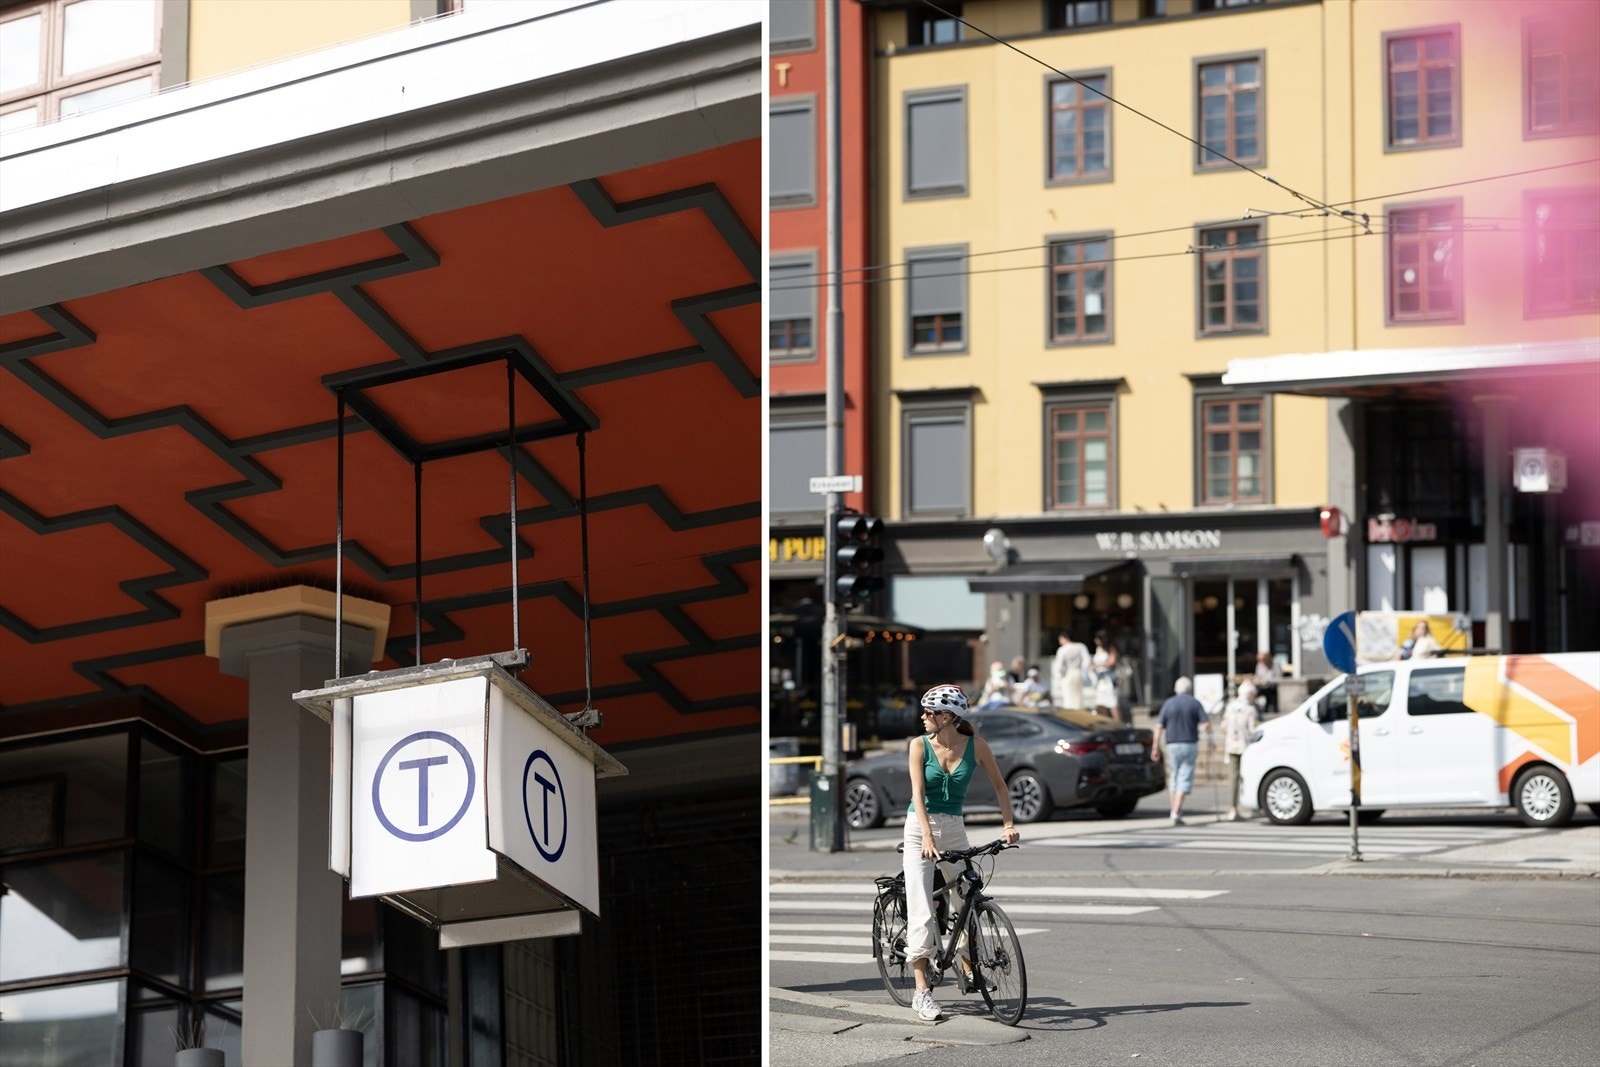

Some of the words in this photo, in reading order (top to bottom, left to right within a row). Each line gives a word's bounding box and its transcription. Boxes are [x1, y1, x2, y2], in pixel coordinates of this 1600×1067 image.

[774, 62, 791, 87] T
[783, 536, 826, 561] PUB
[1139, 529, 1221, 550] SAMSON
[398, 755, 448, 827] T
[533, 771, 556, 846] T
